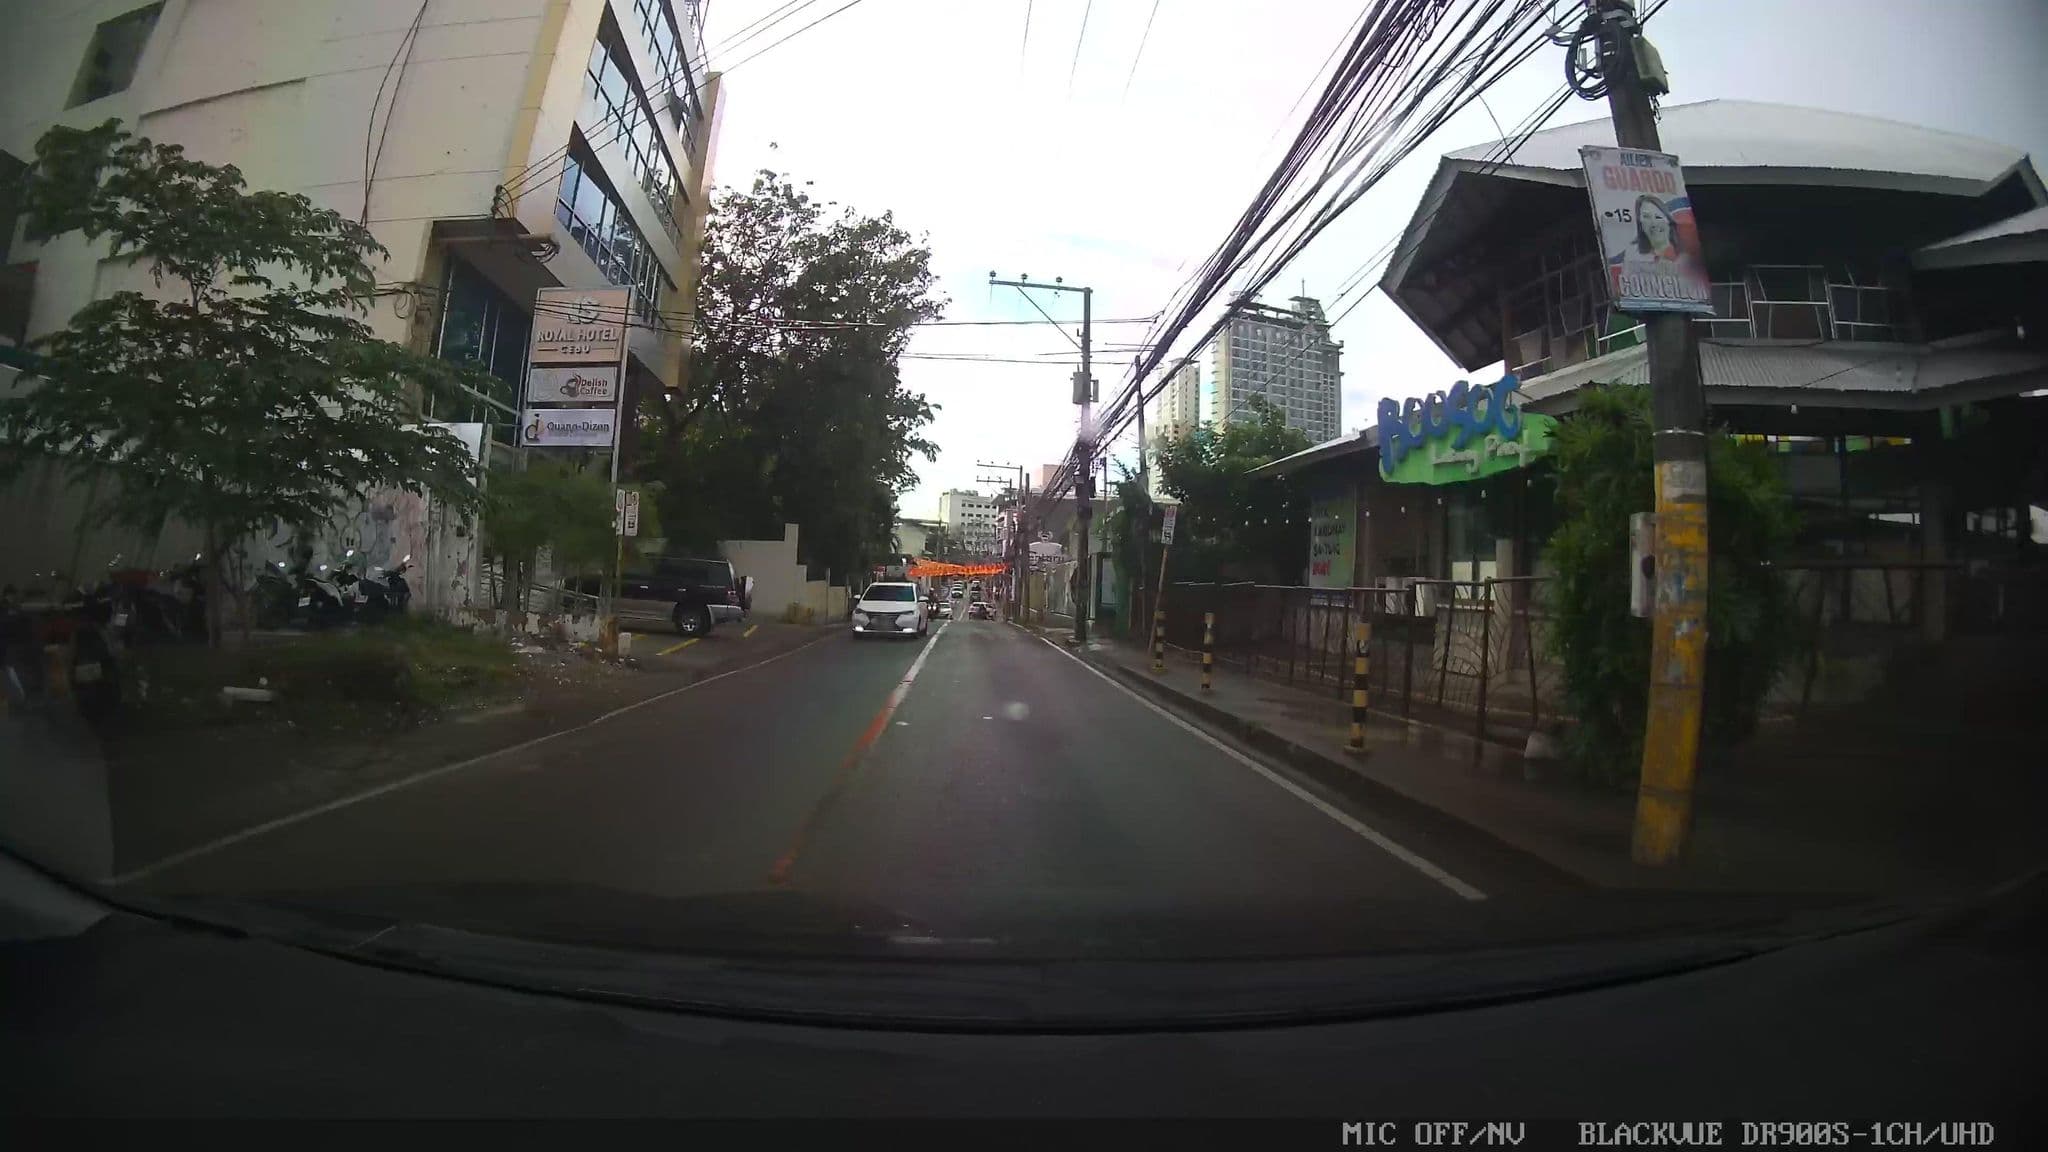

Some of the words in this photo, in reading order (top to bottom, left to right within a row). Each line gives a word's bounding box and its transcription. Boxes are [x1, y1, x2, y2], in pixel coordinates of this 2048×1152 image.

[1603, 165, 1678, 195] GUARDO
[537, 328, 575, 342] ROYAL
[578, 327, 619, 342] HOTEL
[560, 344, 592, 354] CEBU
